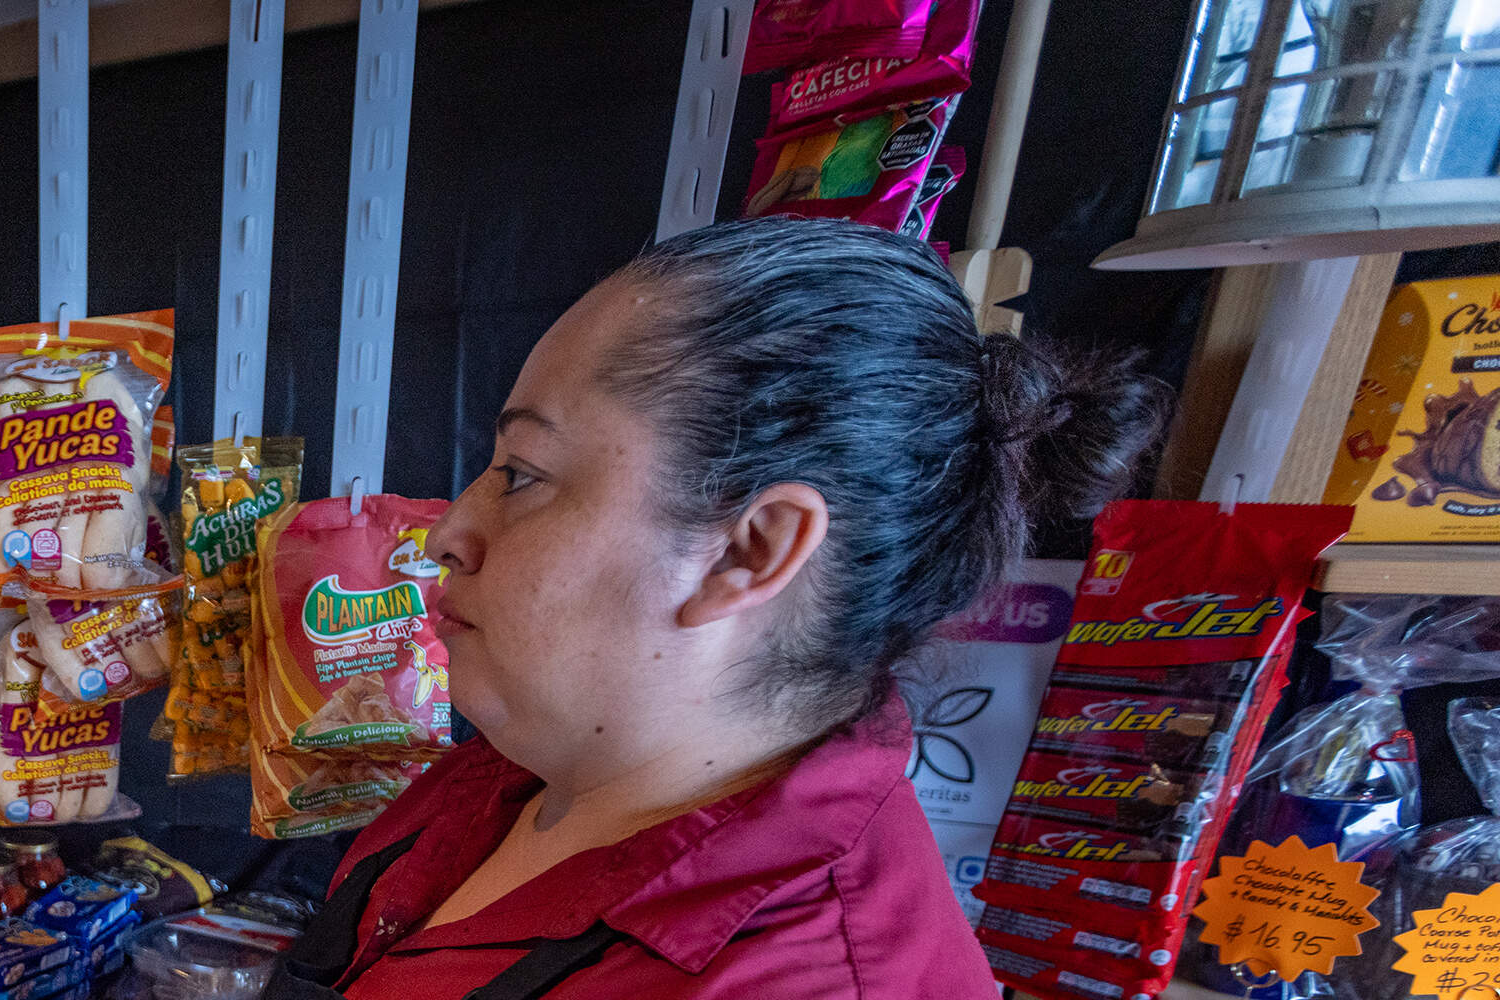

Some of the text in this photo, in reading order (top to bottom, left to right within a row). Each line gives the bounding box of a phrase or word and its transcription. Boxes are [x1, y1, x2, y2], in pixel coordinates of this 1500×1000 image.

[791, 58, 913, 99] CAFECITA
[13, 433, 120, 472] Yucas
[9, 465, 121, 493] Cassava Snacks
[68, 479, 86, 492] de
[89, 477, 133, 493] manioc
[188, 481, 281, 546] ACHIRAS
[201, 534, 251, 573] HUI
[1094, 553, 1129, 579] 10
[71, 604, 123, 634] Cassava
[317, 586, 412, 632] PLANTAIN
[1008, 602, 1050, 627] US
[1065, 597, 1285, 646] Wafer Jet
[378, 619, 421, 638] Chips
[336, 657, 370, 670] Plantain
[372, 652, 396, 664] Chips
[10, 707, 105, 731] Pnde
[1091, 705, 1180, 733] Jet
[21, 720, 111, 752] Yucas
[297, 733, 349, 746] Naturally
[353, 724, 406, 738] Delicious
[16, 750, 108, 771] Cassava Snacks
[2, 768, 61, 781] Collations
[64, 766, 78, 775] de
[1066, 773, 1156, 799] Jet
[918, 786, 972, 802] eritas
[1308, 891, 1348, 911] Mug
[1437, 905, 1500, 923] Choco
[1420, 923, 1471, 937] Coarse
[1424, 940, 1461, 957] Mug
